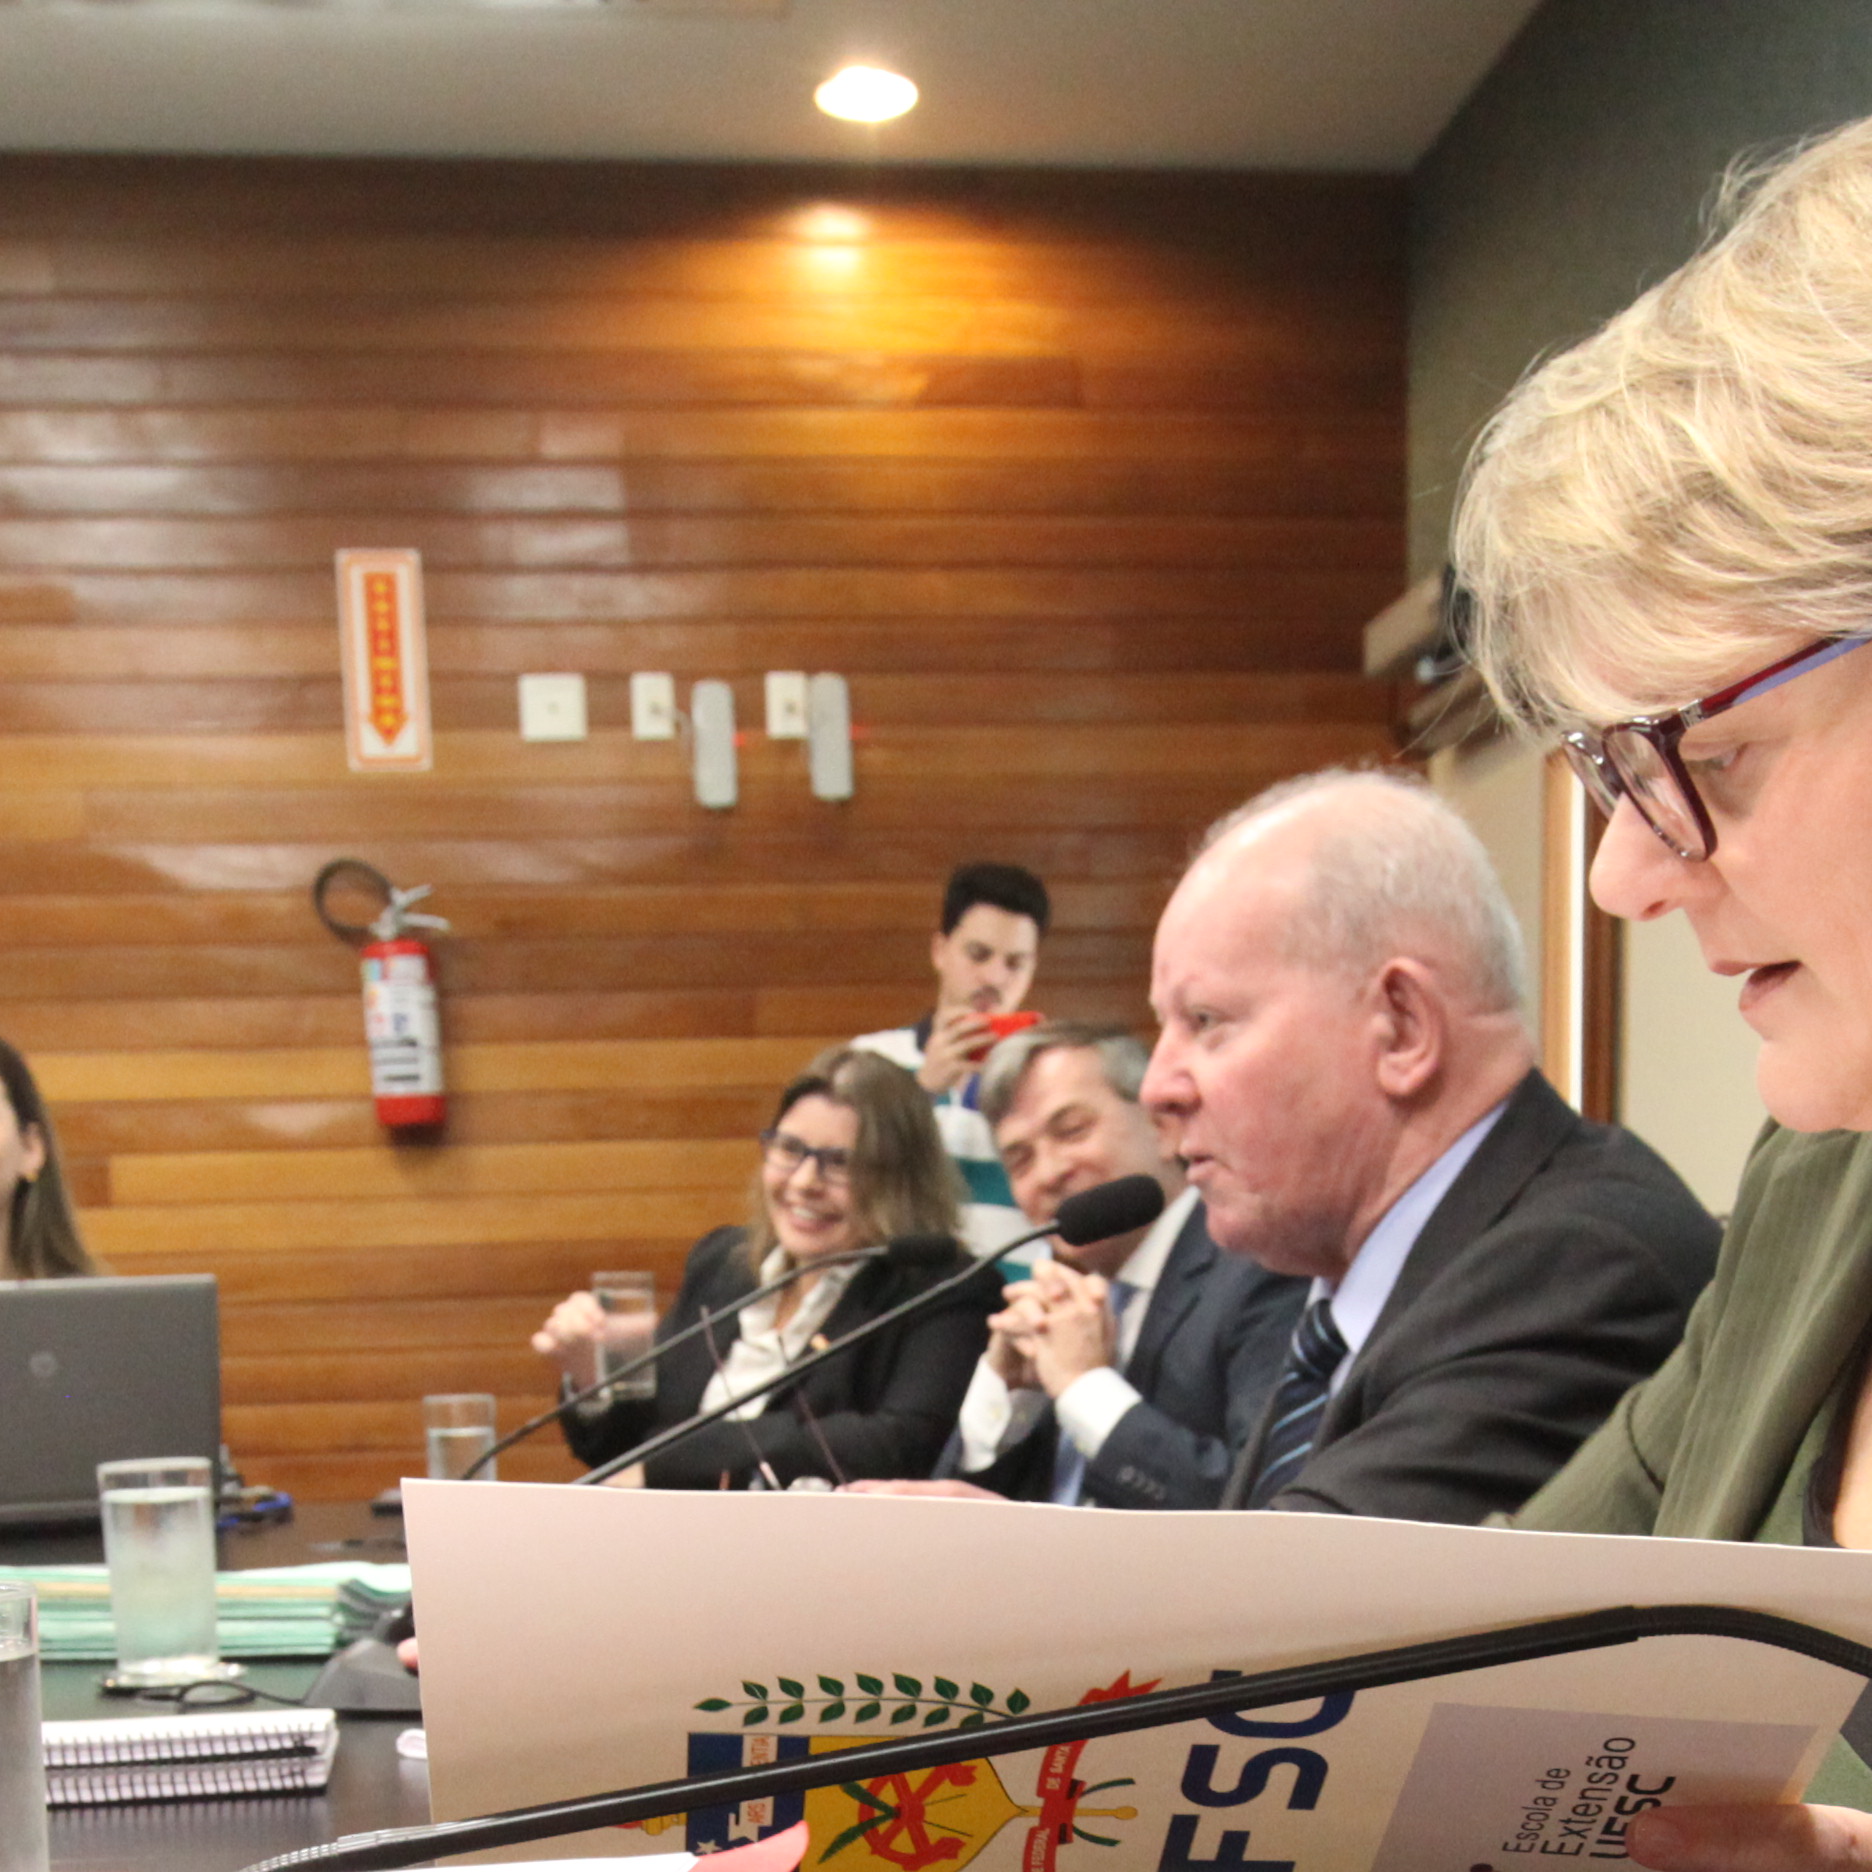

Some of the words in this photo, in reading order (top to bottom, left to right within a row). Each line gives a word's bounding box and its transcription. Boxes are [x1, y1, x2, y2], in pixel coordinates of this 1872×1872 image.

[1502, 1795, 1559, 1853] Escola
[1535, 1767, 1571, 1791] de
[1539, 1737, 1635, 1856] Extensão
